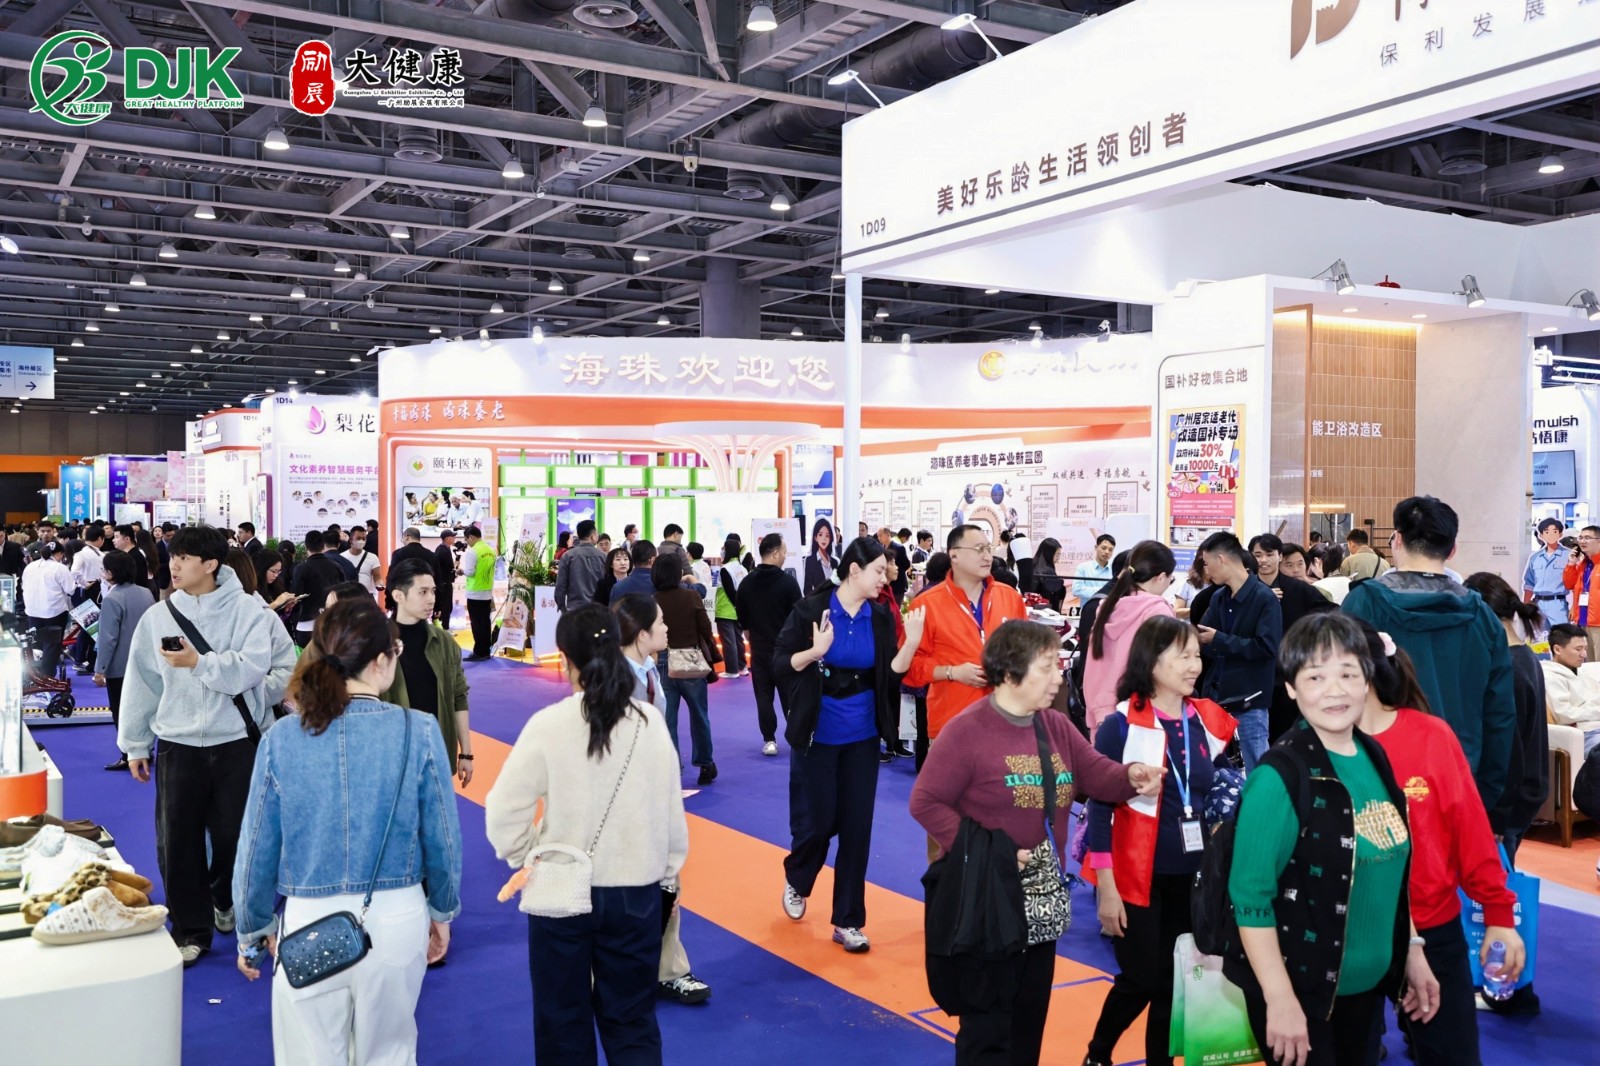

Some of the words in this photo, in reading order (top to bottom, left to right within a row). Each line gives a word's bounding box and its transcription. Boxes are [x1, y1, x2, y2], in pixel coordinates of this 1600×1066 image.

[937, 112, 1187, 216] 美好乐龄生活领创者
[861, 218, 887, 237] 1D09
[559, 351, 836, 392] 海珠欢迎您
[1164, 367, 1249, 390] 国补好物集合地
[335, 413, 376, 433] 梨花
[1312, 420, 1383, 437] 能卫浴改造区
[1177, 425, 1239, 443] 改造国补专场
[433, 457, 483, 469] 颐年医养
